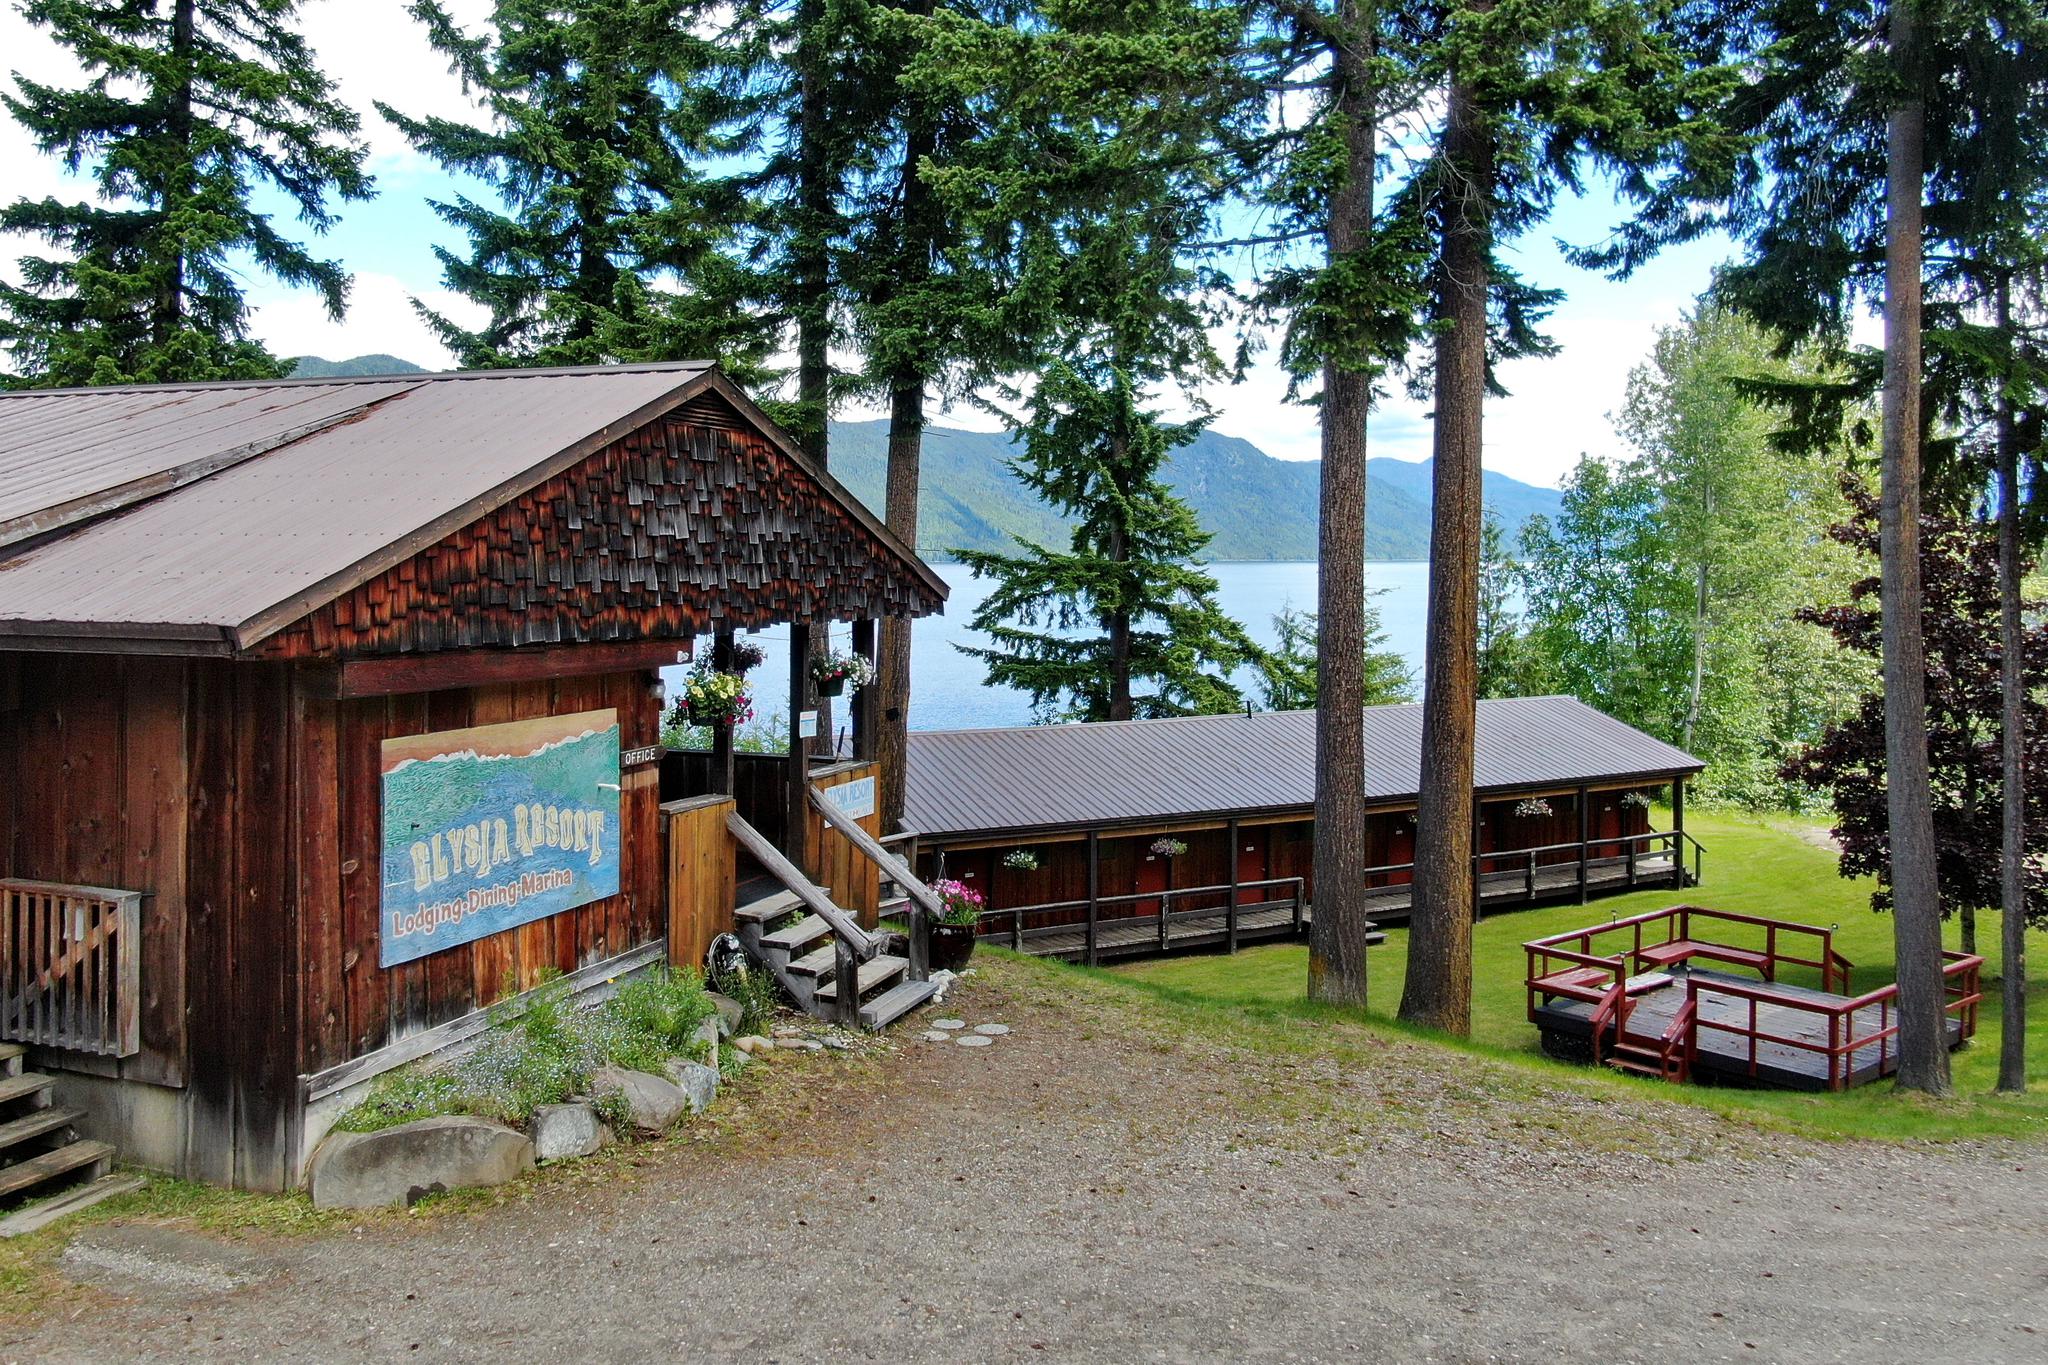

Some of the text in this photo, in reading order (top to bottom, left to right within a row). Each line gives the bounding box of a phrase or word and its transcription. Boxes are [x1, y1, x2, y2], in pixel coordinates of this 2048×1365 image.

[625, 748, 656, 765] OFFICE
[409, 803, 604, 892] ELYSIA RESORT
